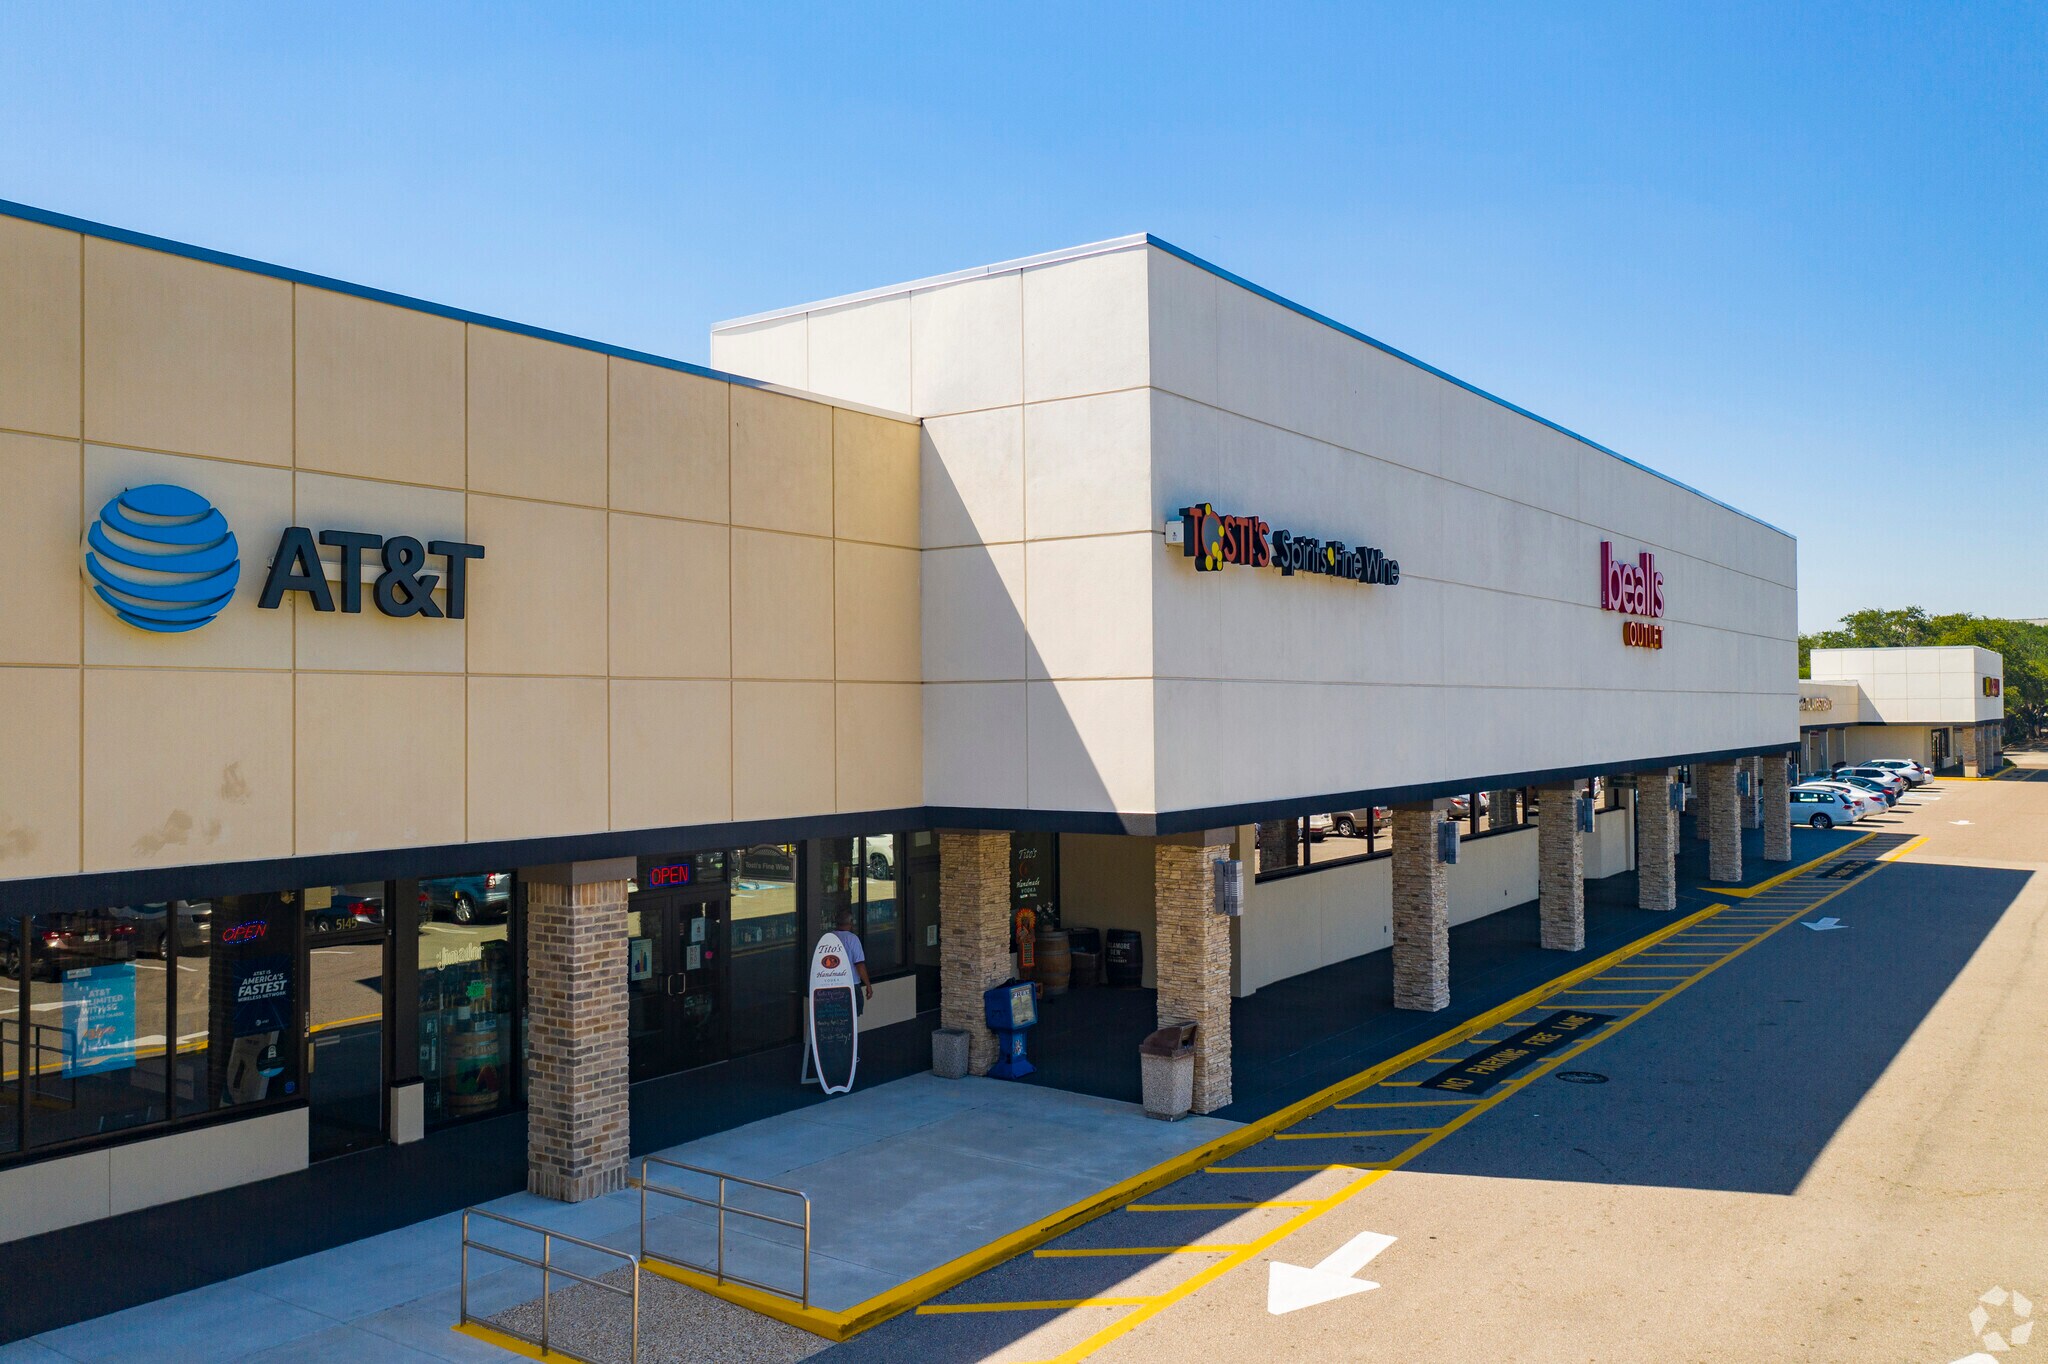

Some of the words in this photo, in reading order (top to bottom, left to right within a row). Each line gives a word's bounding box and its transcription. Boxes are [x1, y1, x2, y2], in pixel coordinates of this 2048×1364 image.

[1272, 530, 1328, 576] Spirits
[1330, 541, 1363, 579] Fine
[1360, 546, 1399, 585] Wine
[258, 527, 485, 620] AT&T
[1600, 541, 1664, 618] bealls
[1623, 621, 1664, 649] OUTLET
[651, 865, 689, 886] OPEN
[223, 924, 267, 941] OPEN
[336, 917, 358, 931] 5145
[818, 944, 843, 954] Tito's
[242, 973, 284, 986] AMERICA'S
[816, 969, 847, 979] Handmade
[88, 988, 111, 998] AT&T
[237, 994, 262, 1003] WIRELESS
[262, 990, 287, 999] NETWORK
[238, 980, 288, 997] FASTEST
[1437, 1078, 1474, 1091] NO
[1465, 1048, 1530, 1075] PARKING
[1522, 1032, 1563, 1046] FIRE
[1552, 1015, 1593, 1030] LANE
